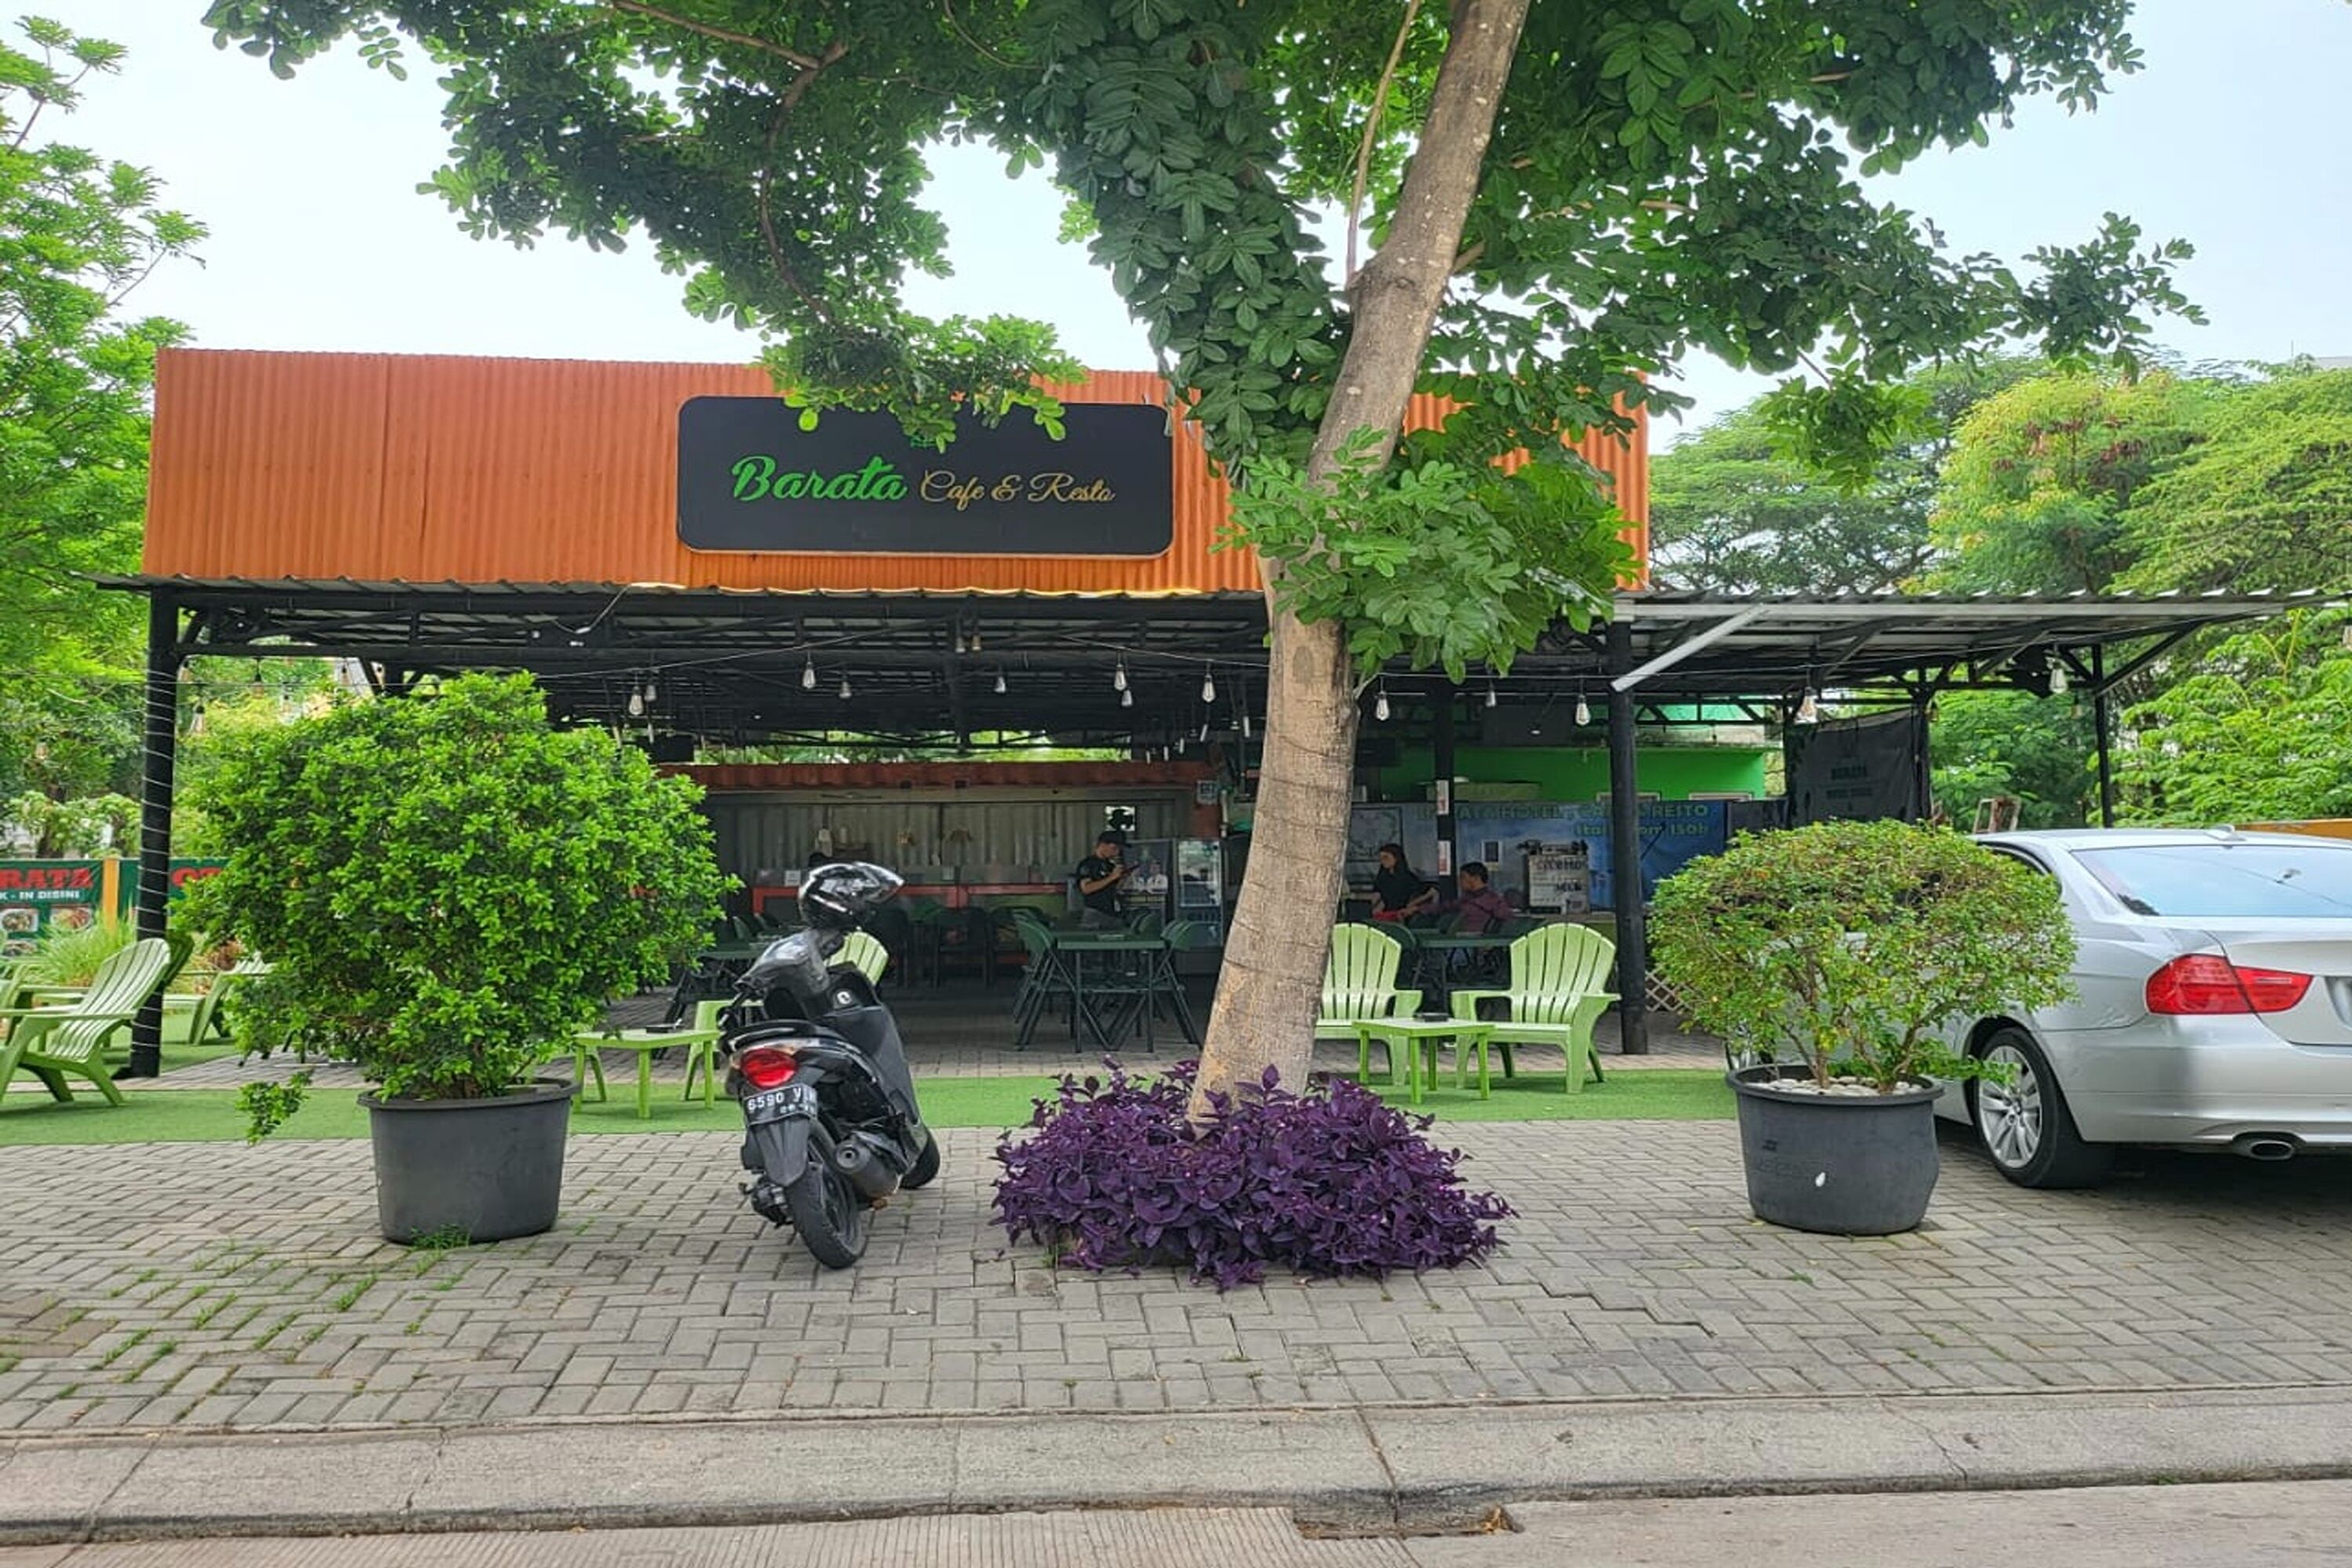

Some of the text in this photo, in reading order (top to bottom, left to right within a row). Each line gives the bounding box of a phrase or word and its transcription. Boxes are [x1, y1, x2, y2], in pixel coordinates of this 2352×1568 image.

[732, 455, 1116, 511] Barata Cafe & Resto
